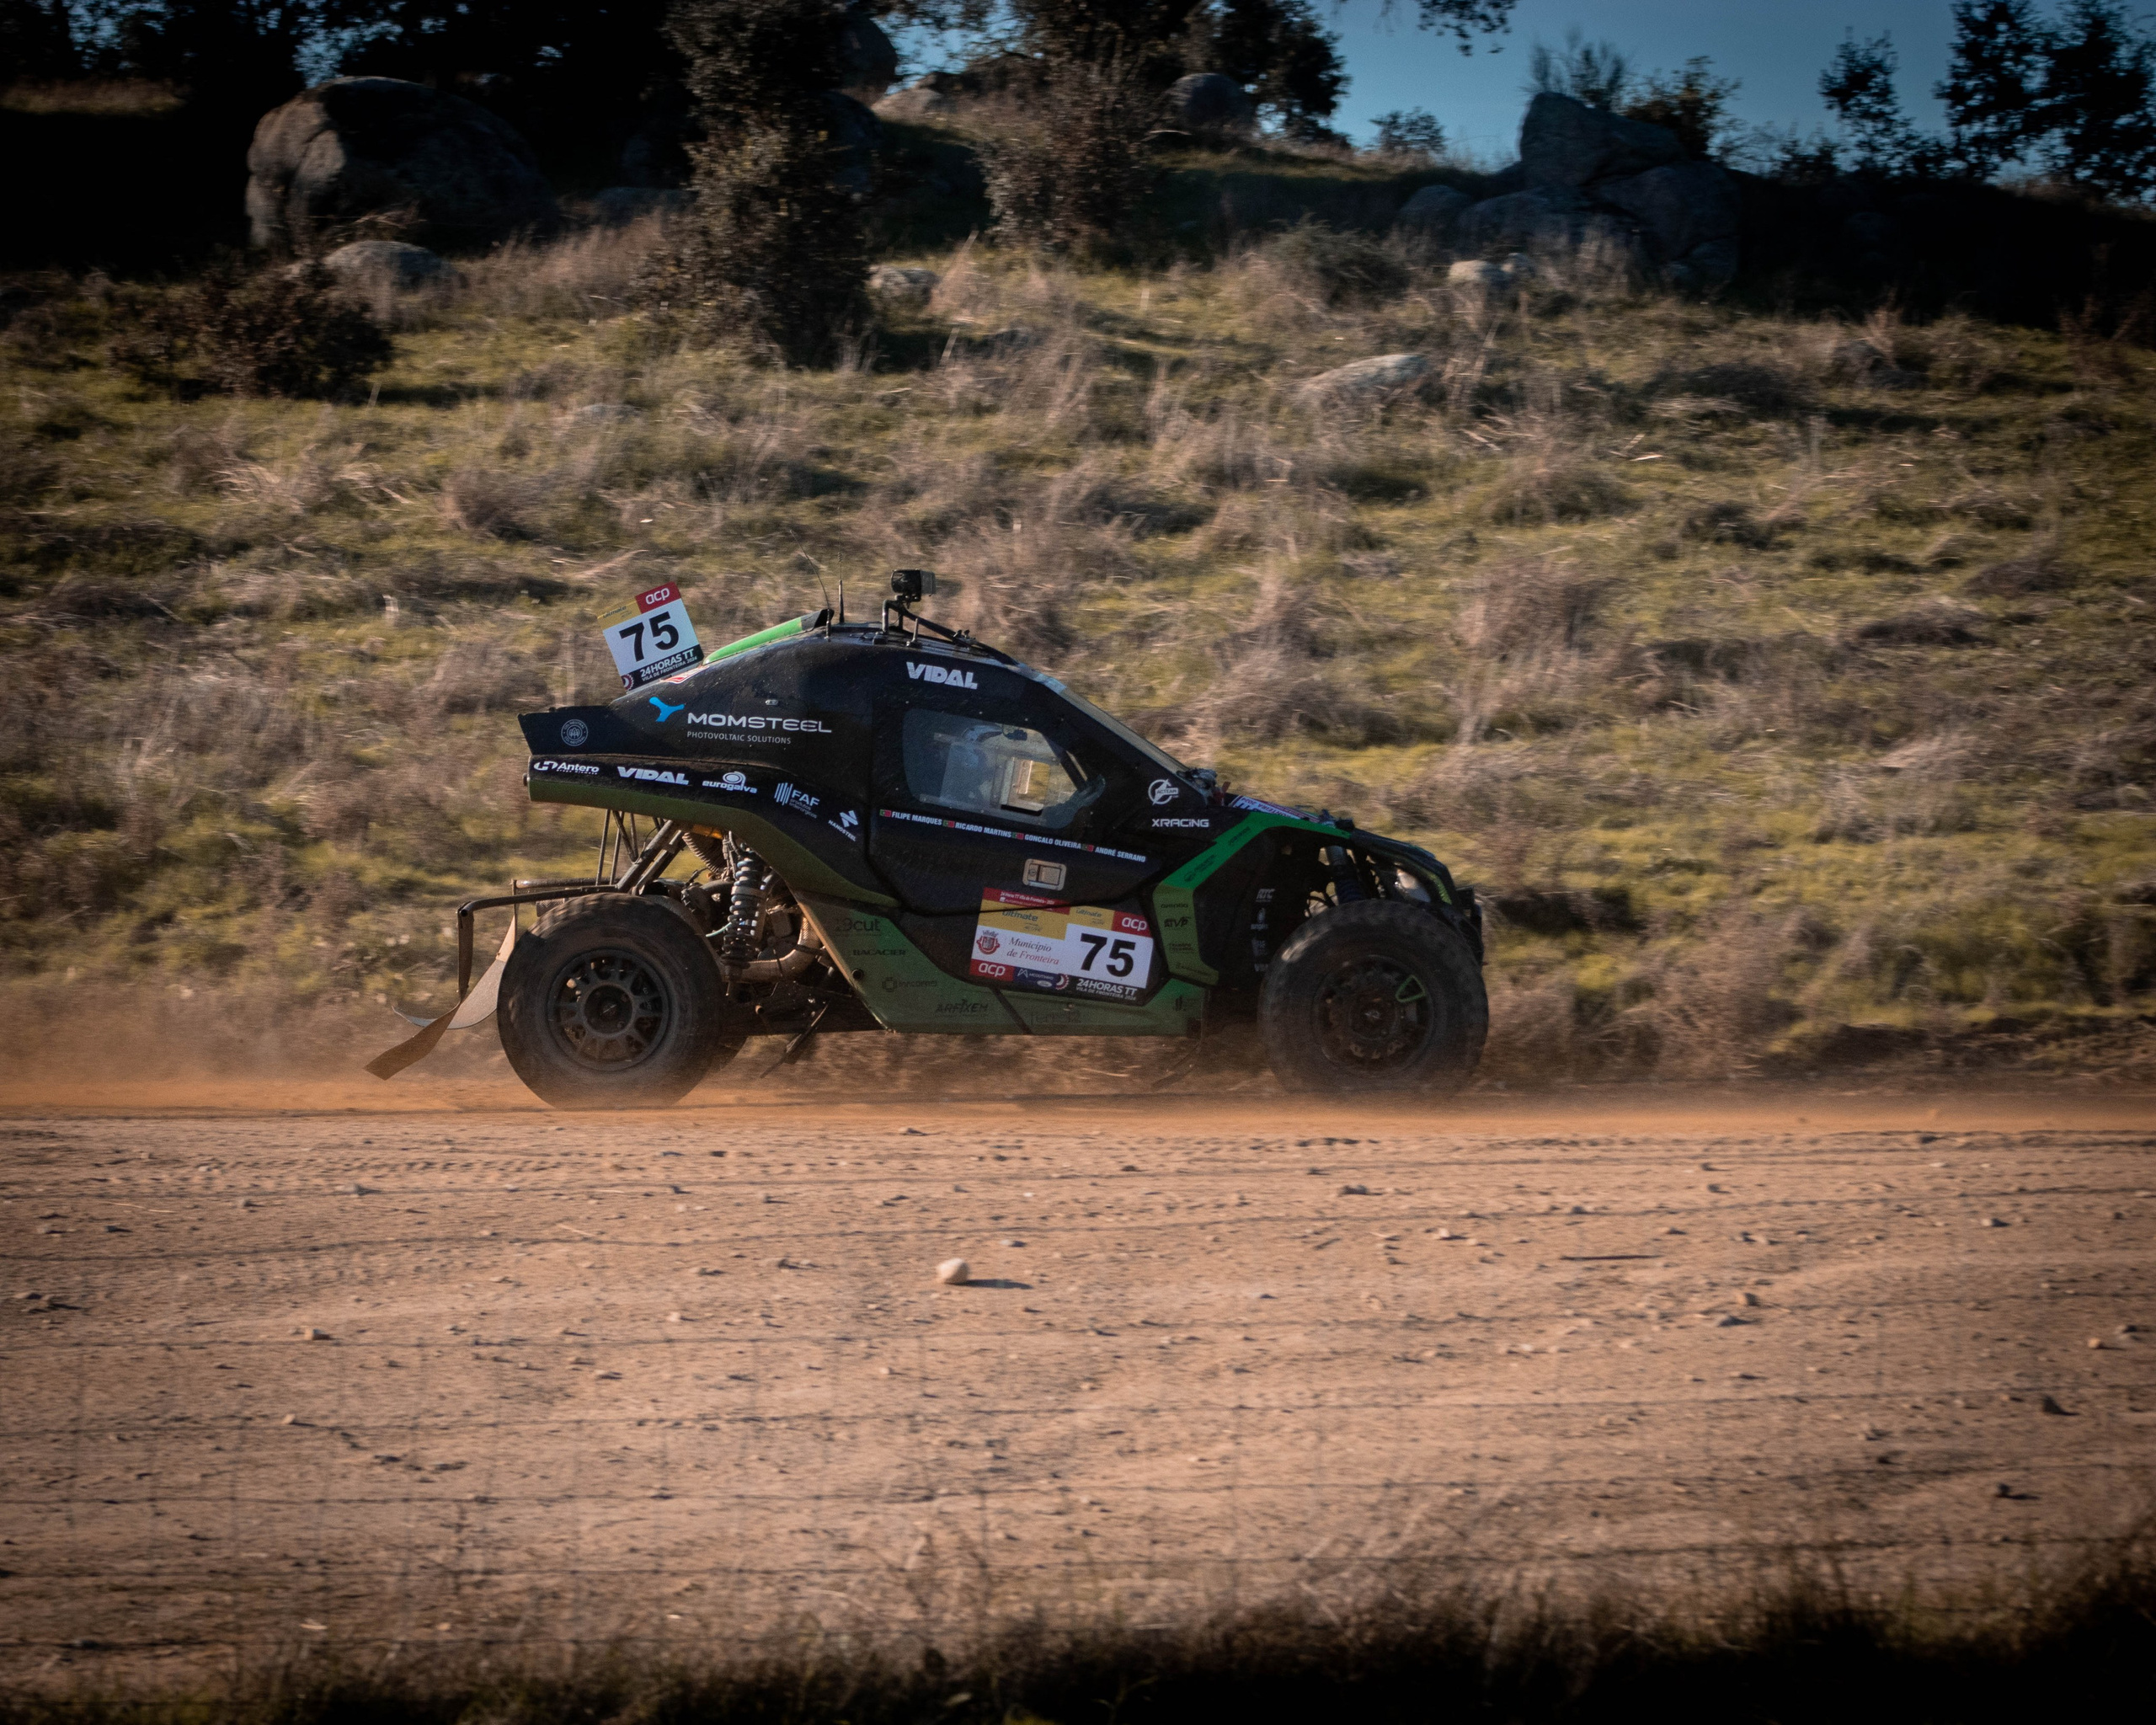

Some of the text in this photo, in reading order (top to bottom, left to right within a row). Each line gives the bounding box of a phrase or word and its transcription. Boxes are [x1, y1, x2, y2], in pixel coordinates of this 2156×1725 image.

[645, 587, 670, 606] acp
[619, 611, 679, 662] 75
[682, 649, 694, 659] TT
[660, 660, 686, 675] FRONTEIRA
[906, 662, 978, 690] VIDAL
[687, 712, 832, 734] MOMSTEEL
[687, 731, 792, 745] PHOTOVOLTAIC SOLUTIONS
[557, 761, 600, 773] Antero
[617, 766, 689, 786] VIDAL
[702, 774, 757, 793] eurogalva
[792, 789, 820, 806] FAF
[892, 811, 942, 825] FILIPE MARQUES
[828, 820, 857, 841] NANOSTEEL
[955, 822, 1012, 838] RICARDO MARTINS
[1054, 839, 1081, 850] OLIVEIRA
[1095, 846, 1146, 862] ANDRÉ SERRANO
[1002, 911, 1038, 921] ultimate
[1075, 908, 1102, 917] ultimate
[1122, 917, 1147, 932] acp
[1006, 948, 1059, 965] de Fronteira
[1081, 932, 1136, 977] 75
[978, 963, 1006, 977] acp
[1096, 990, 1123, 999] FRONTEIRA
[1124, 986, 1138, 996] TT
